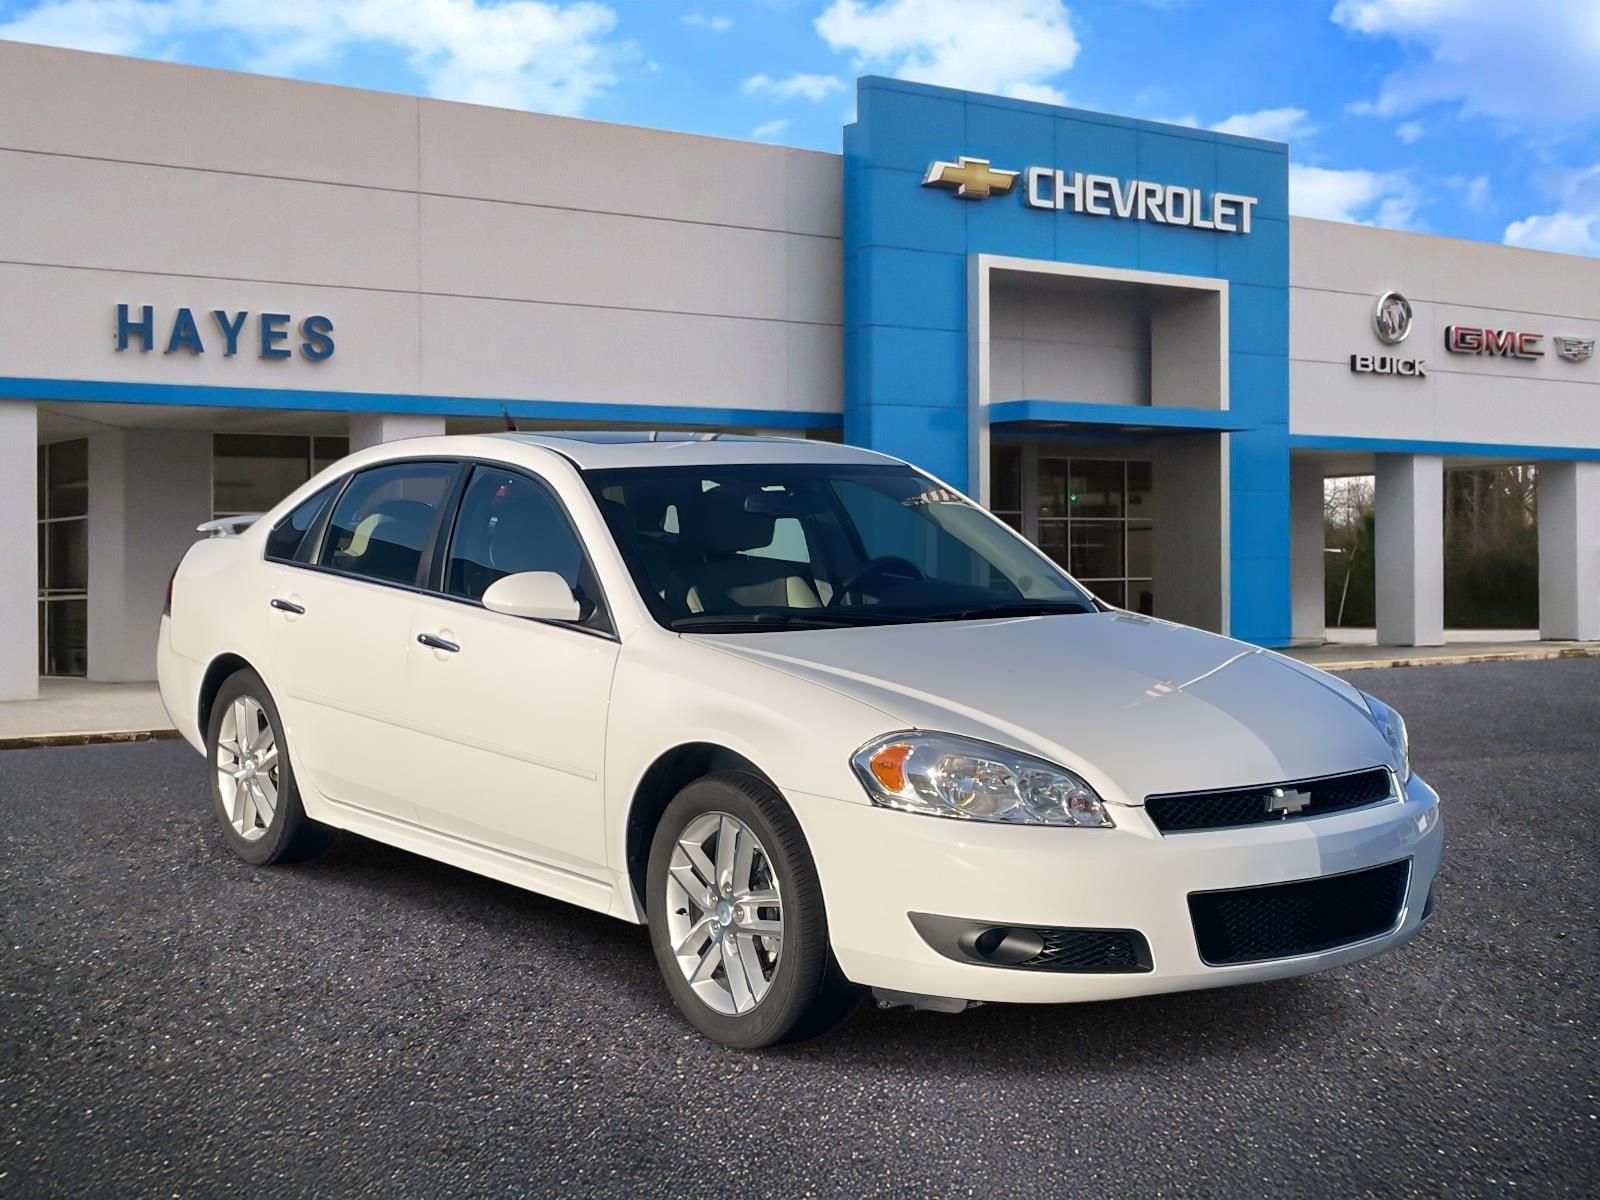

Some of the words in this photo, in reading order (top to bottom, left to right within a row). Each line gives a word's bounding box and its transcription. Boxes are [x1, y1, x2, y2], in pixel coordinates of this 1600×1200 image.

[1026, 166, 1258, 234] CHEVROLET
[115, 303, 335, 361] HAYES
[1446, 325, 1546, 359] GMC
[1351, 354, 1427, 377] BUICK
